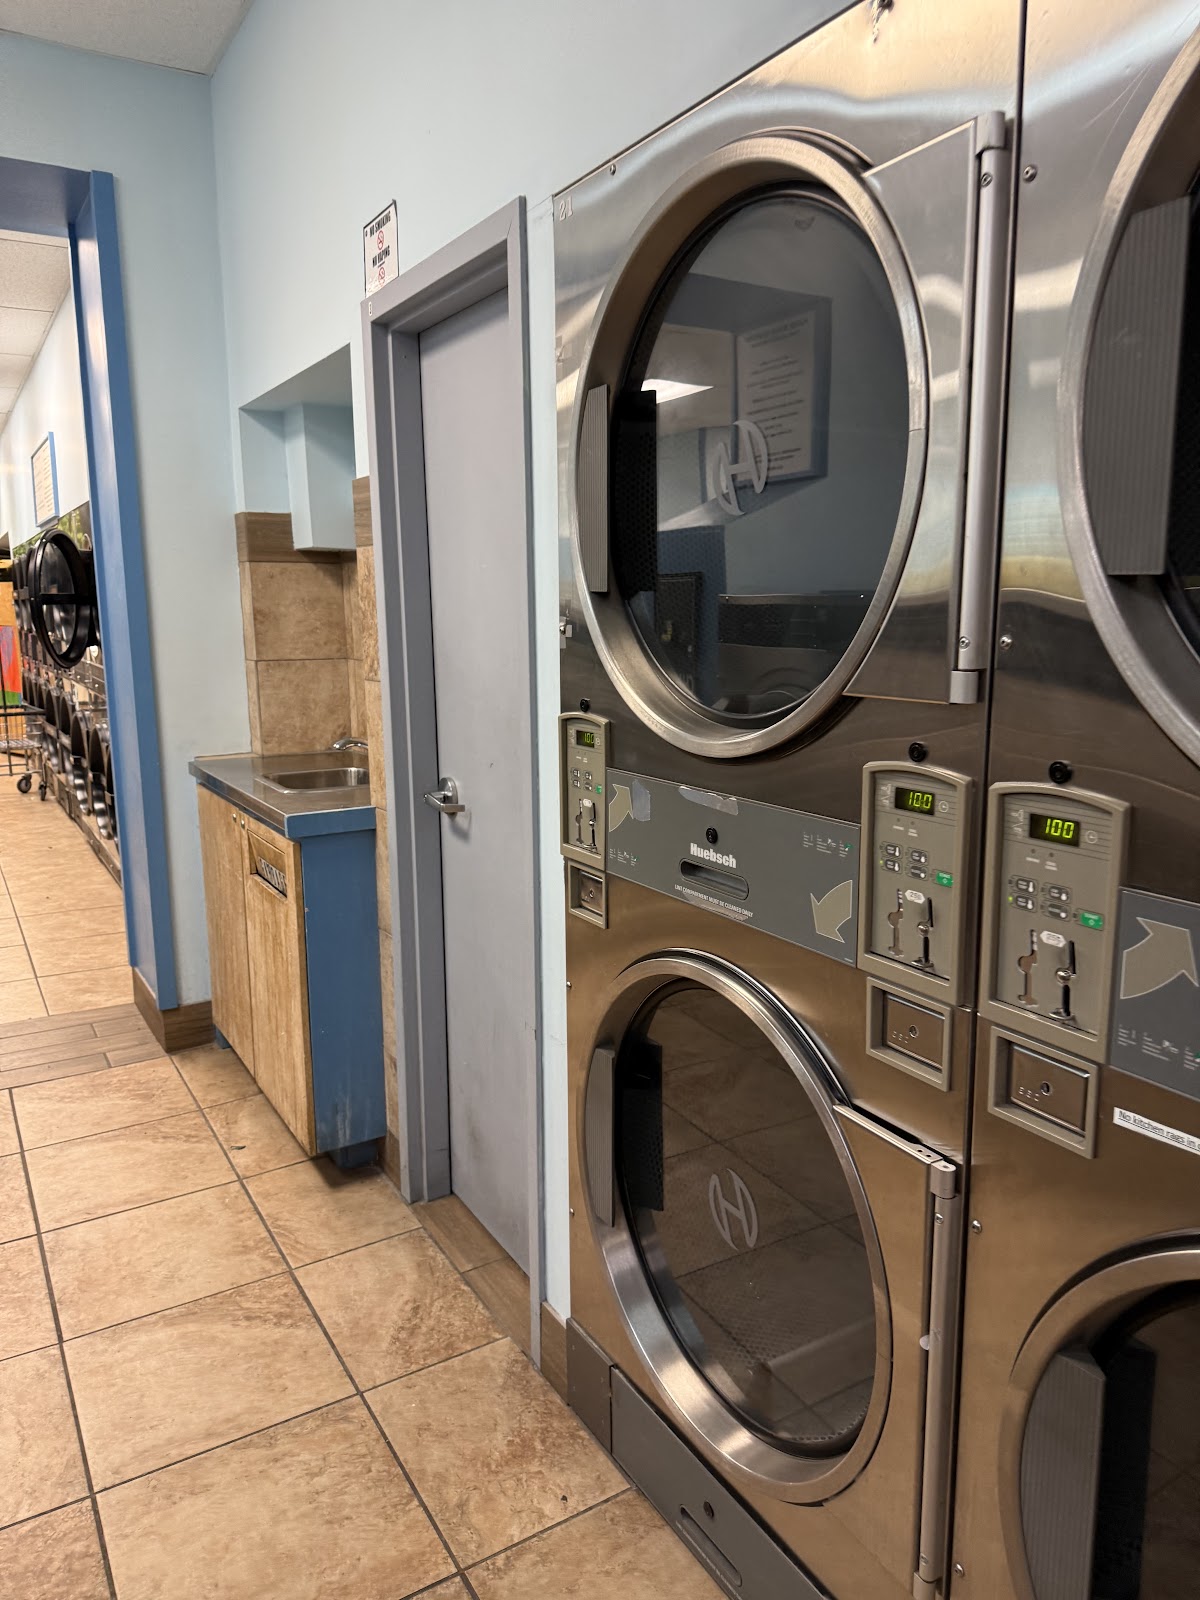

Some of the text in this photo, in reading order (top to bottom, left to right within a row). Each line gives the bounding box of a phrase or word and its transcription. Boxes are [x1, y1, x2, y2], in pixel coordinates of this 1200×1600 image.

[375, 210, 391, 233] SMOKING
[378, 245, 390, 264] VAPING
[1045, 818, 1075, 839] 100
[690, 842, 737, 869] Huebsch
[1119, 1110, 1132, 1122] No
[1133, 1115, 1165, 1136] kitchen
[1166, 1130, 1186, 1145] rags
[1187, 1137, 1197, 1148] in
